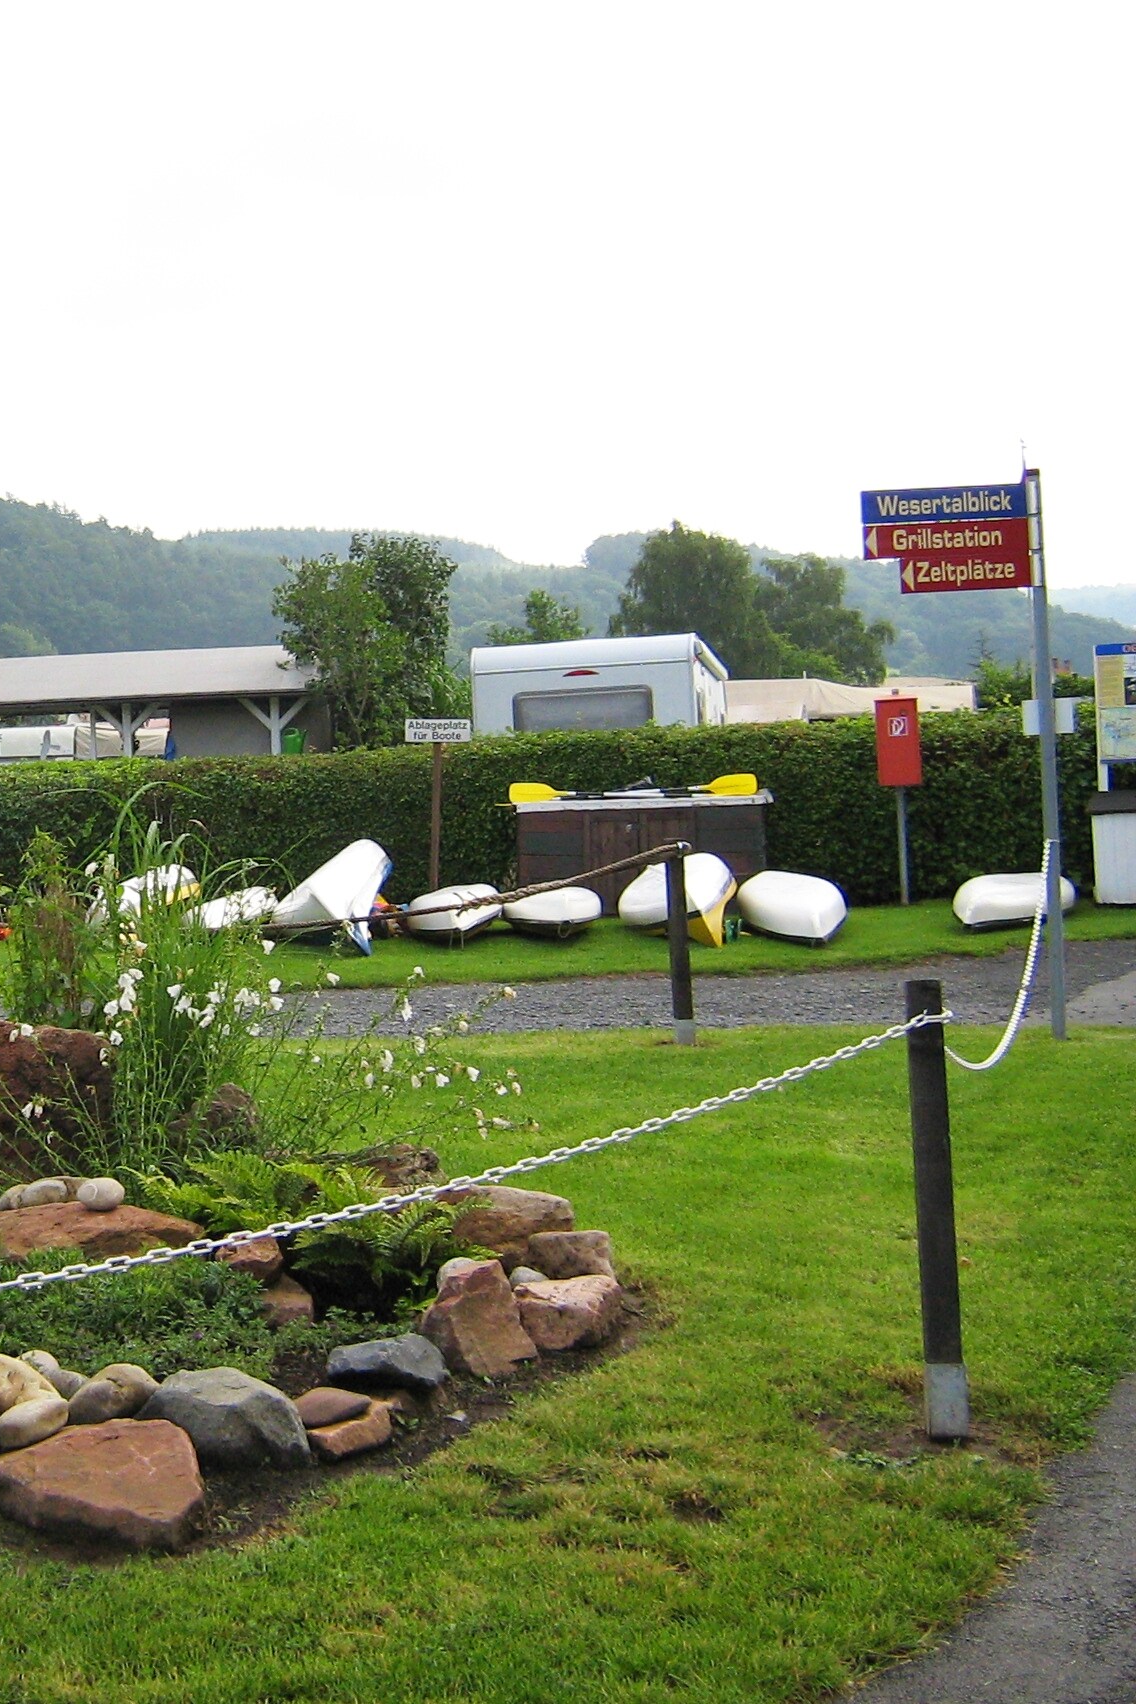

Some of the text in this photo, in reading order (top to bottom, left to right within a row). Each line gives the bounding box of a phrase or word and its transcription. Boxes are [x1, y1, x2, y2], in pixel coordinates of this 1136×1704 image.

[877, 491, 1011, 516] Wesertalblick
[893, 526, 1002, 550] Grillstation
[917, 560, 1015, 586] Zeltplätze
[408, 721, 467, 731] Ablageplatz
[432, 732, 462, 740] Boote
